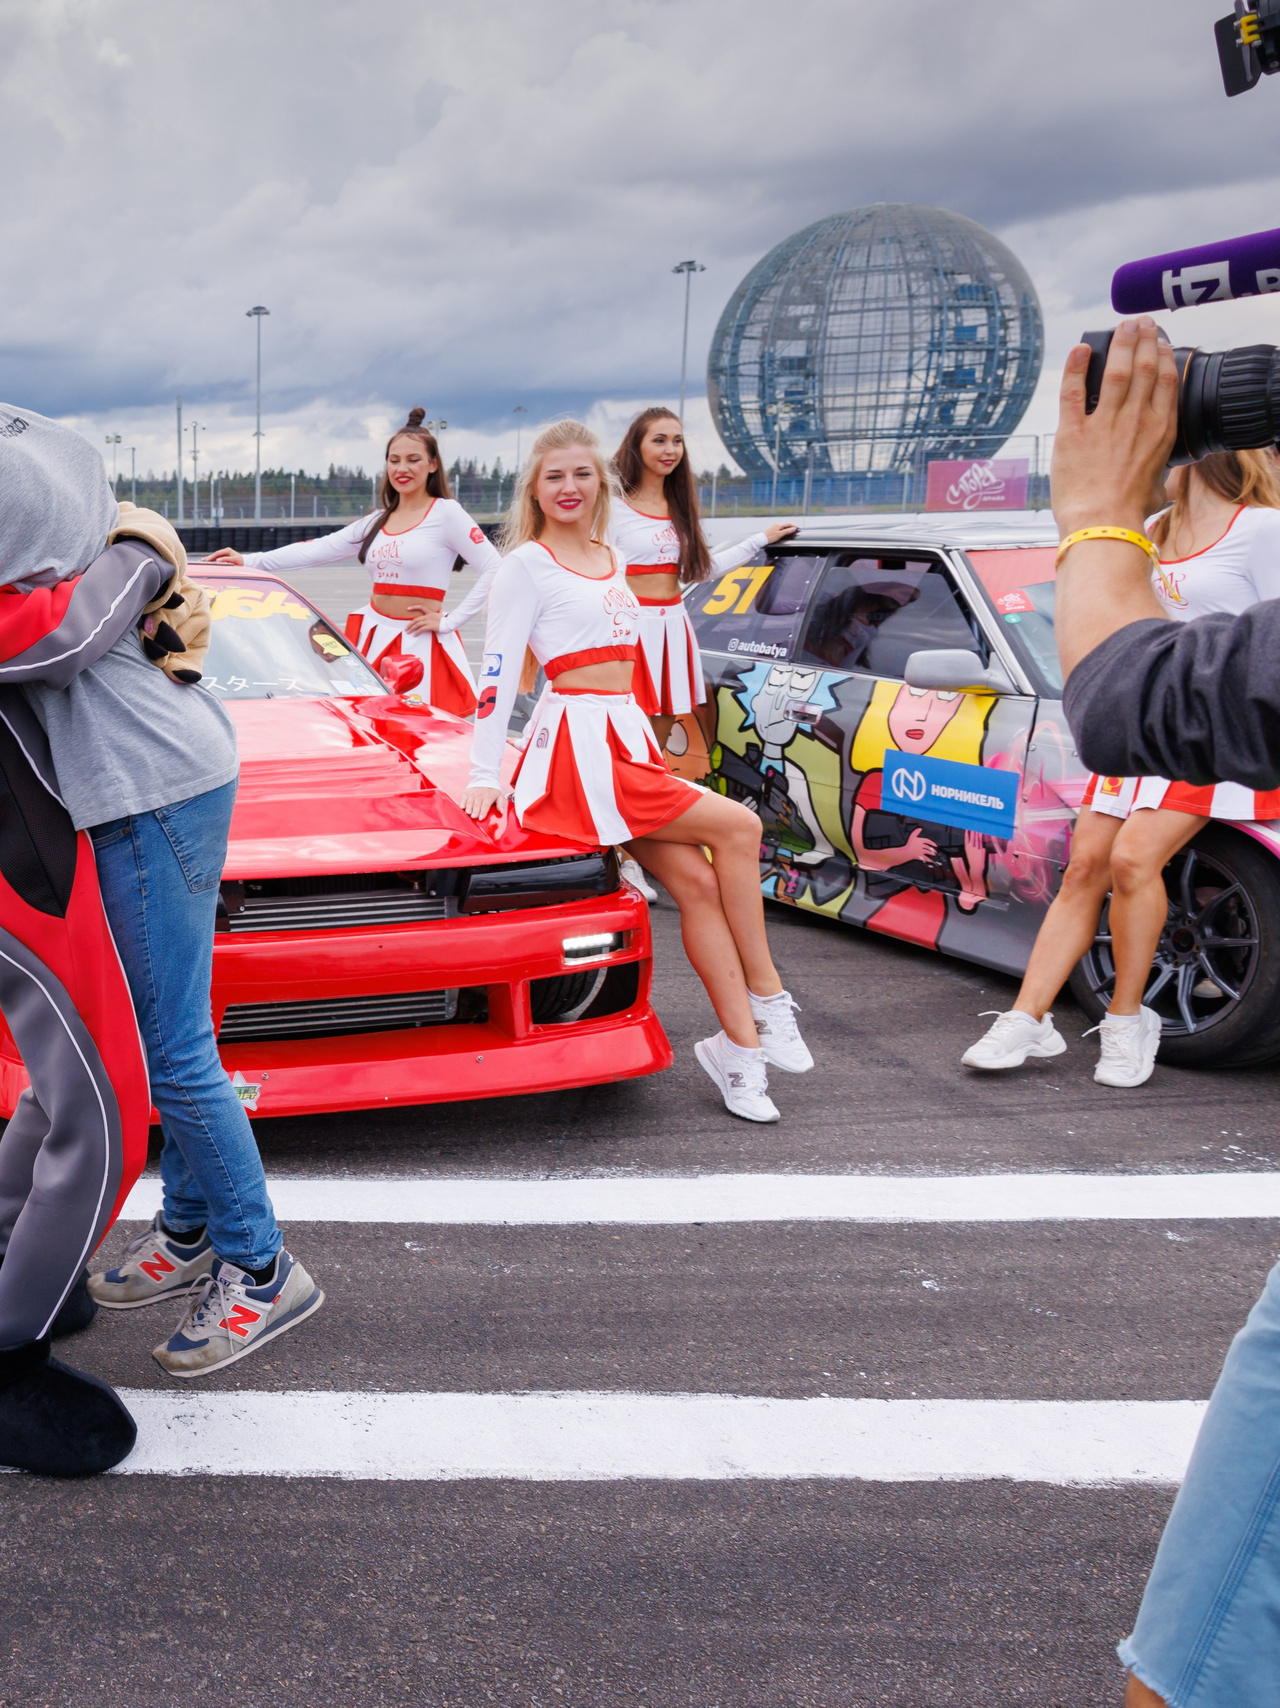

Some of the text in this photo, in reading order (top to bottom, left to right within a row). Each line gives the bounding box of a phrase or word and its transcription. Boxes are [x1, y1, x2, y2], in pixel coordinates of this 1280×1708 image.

[931, 784, 1005, 810] НОРНИКЕЛЬ
[138, 1251, 177, 1283] N
[218, 1303, 263, 1340] N
